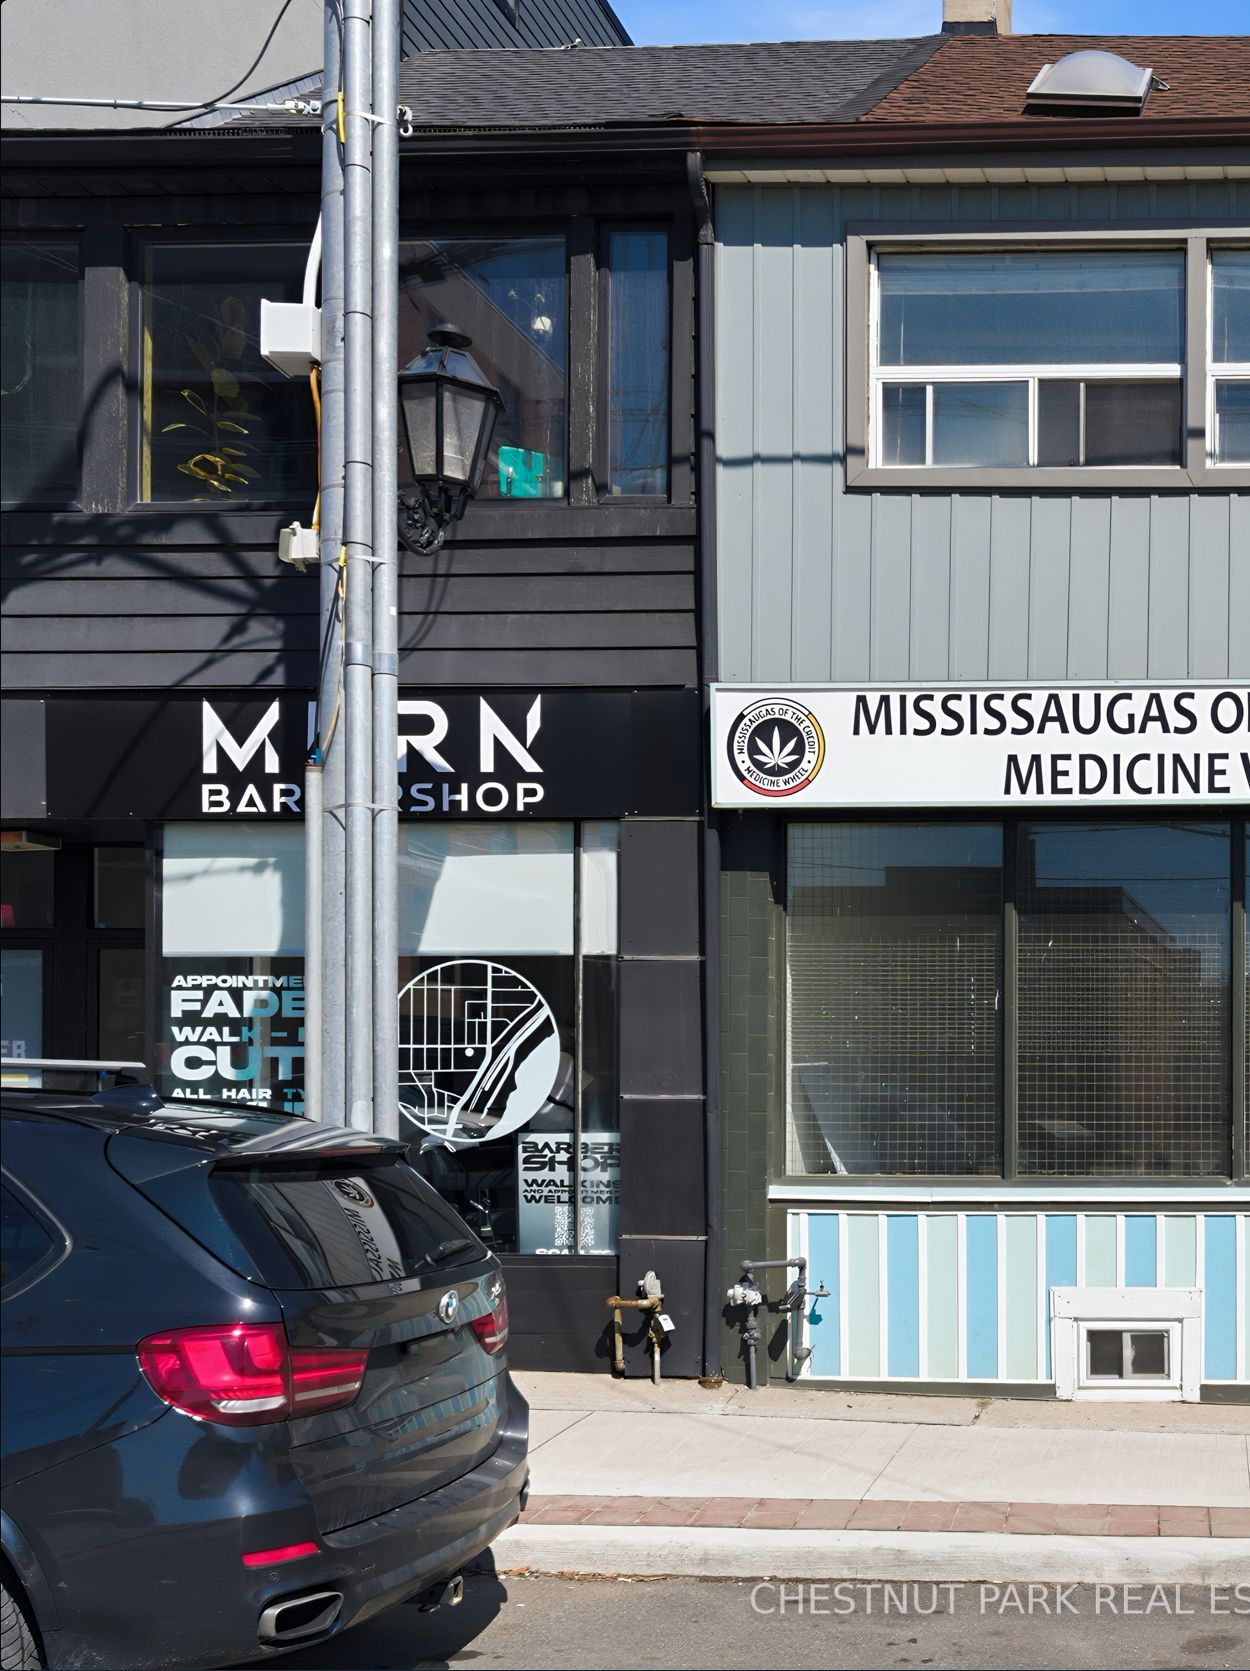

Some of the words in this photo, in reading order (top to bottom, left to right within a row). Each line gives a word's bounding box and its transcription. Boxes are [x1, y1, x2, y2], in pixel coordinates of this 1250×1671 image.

[778, 707, 789, 717] OF
[853, 692, 1198, 736] MISSISSAUGAS
[203, 694, 544, 774] MRN
[744, 766, 781, 788] MEDICINE
[1003, 752, 1231, 795] MEDICINE
[202, 782, 545, 813] BARSHOP
[171, 975, 304, 988] APPOINTME
[171, 1087, 211, 1099] ALL
[222, 1088, 272, 1099] HAIR
